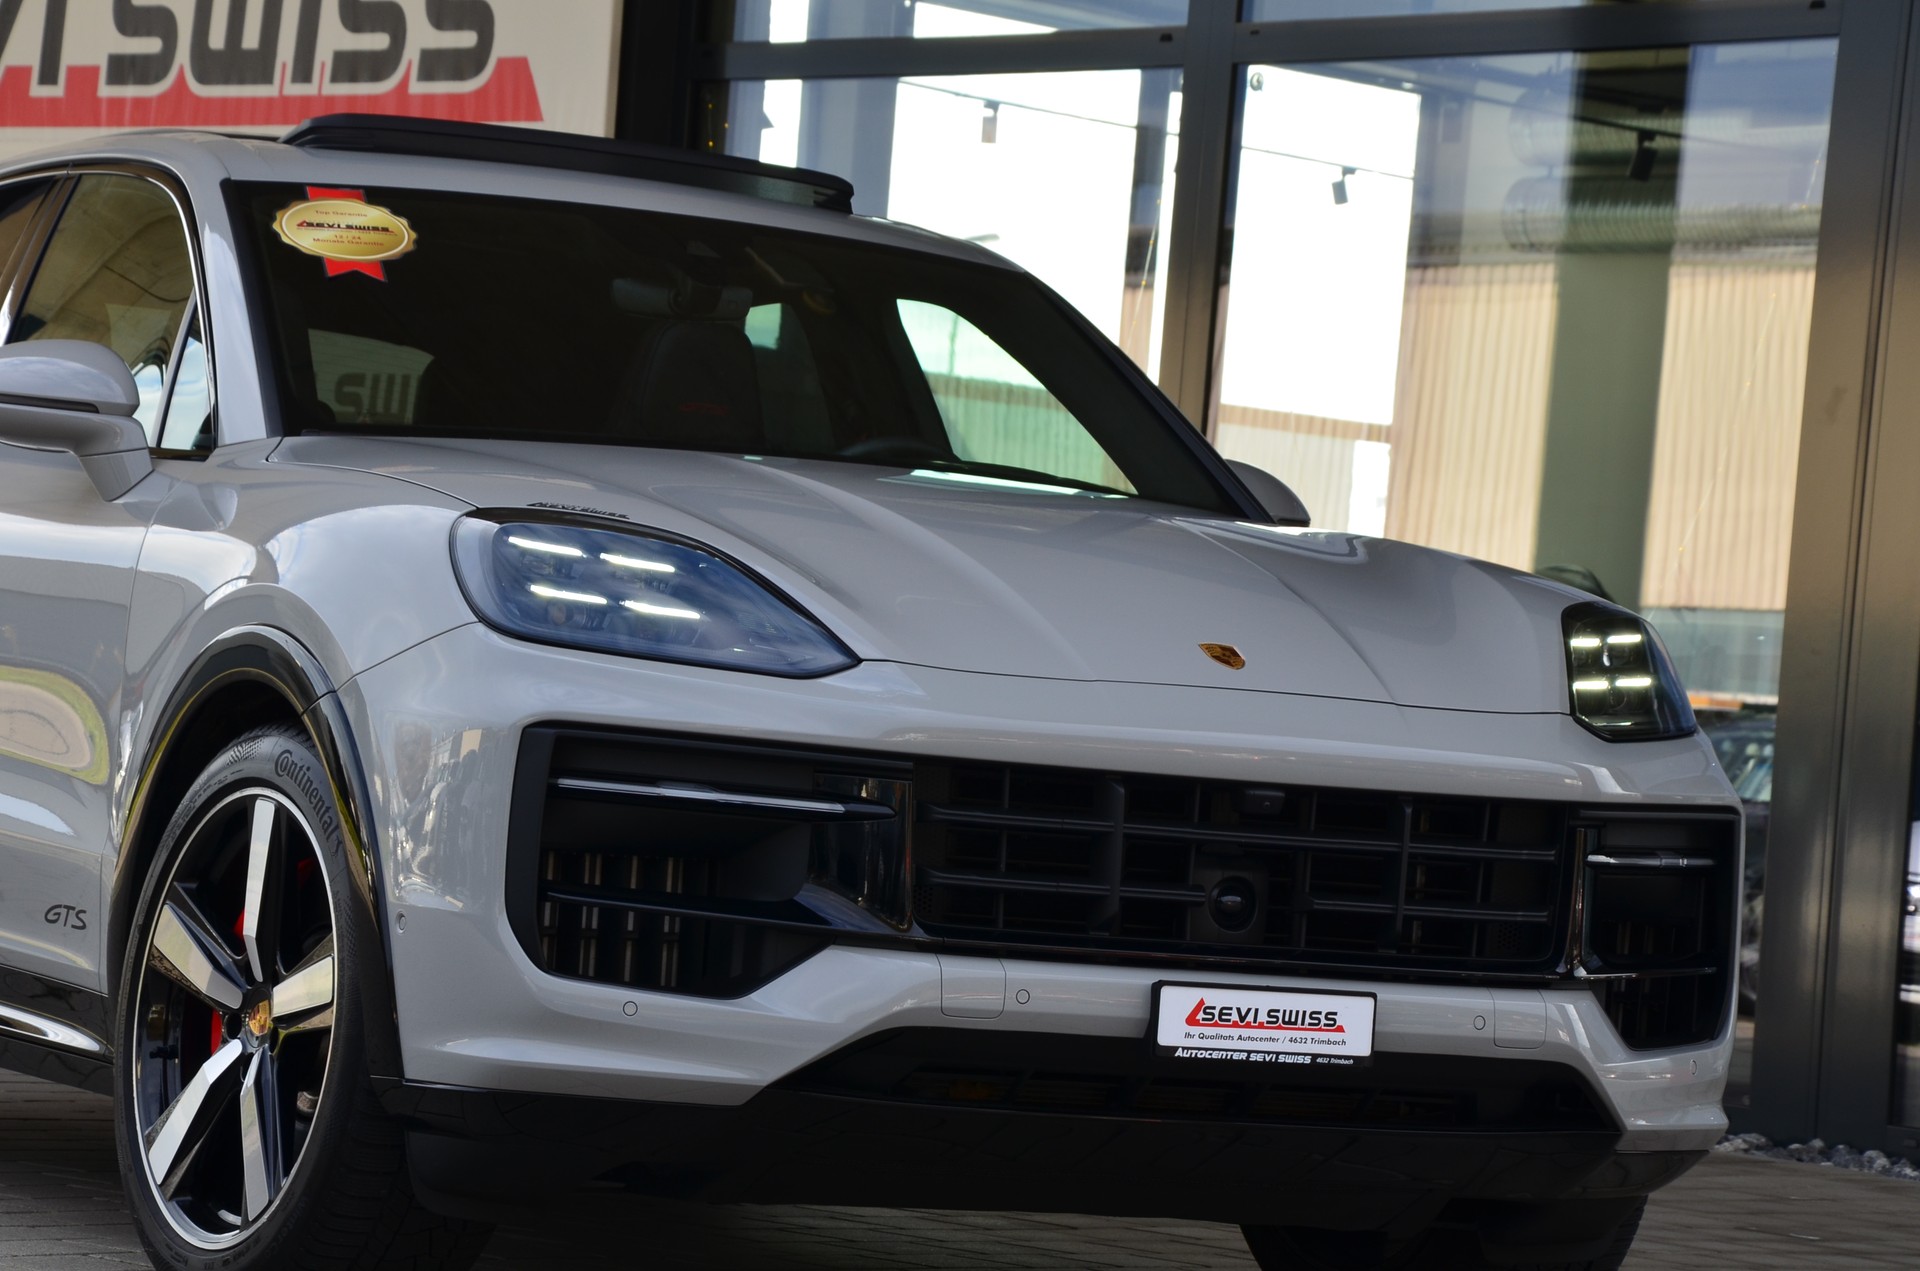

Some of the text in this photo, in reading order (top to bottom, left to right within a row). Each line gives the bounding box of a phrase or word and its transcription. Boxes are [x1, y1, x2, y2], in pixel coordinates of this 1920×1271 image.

[345, 223, 389, 232] SWISS
[274, 749, 339, 841] Continental
[44, 904, 87, 930] GTS
[1201, 1005, 1338, 1027] SEVI SWISS
[1184, 1031, 1196, 1039] Ihr
[1198, 1032, 1234, 1041] Qualitats
[1237, 1034, 1280, 1043] Autocenter
[1288, 1036, 1308, 1045] 4632
[1310, 1037, 1347, 1046] Trimbach
[1249, 1052, 1276, 1062] SEVI
[1277, 1054, 1312, 1064] SWISS
